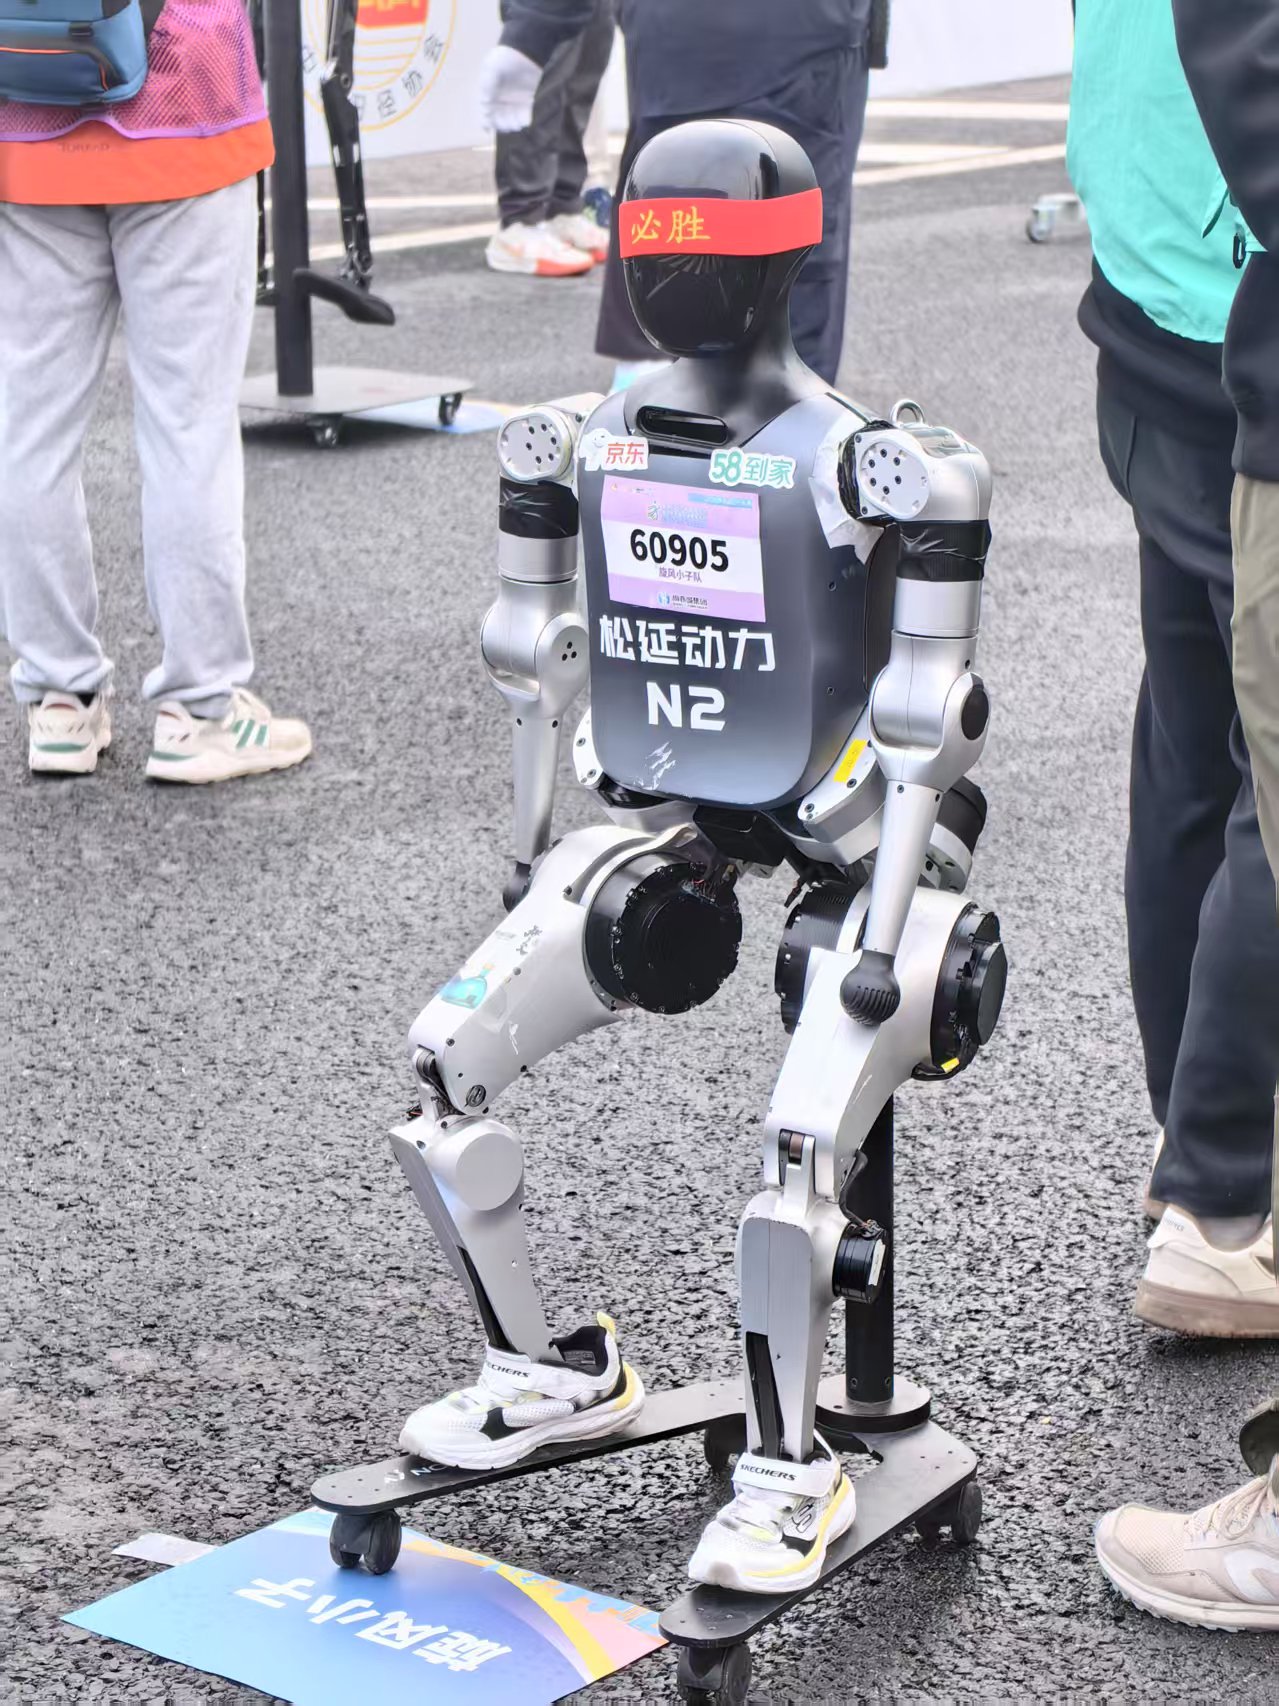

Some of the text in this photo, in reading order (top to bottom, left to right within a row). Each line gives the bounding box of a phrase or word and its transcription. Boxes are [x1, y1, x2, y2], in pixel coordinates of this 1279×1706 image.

[631, 206, 711, 244] 必胜
[606, 442, 645, 465] 京东
[711, 450, 794, 486] 58到家
[630, 528, 729, 572] 60905
[658, 566, 703, 584] 旋风小子队
[599, 614, 776, 671] 松延动力
[646, 681, 726, 732] N2
[740, 1463, 797, 1481] SKECHERS
[234, 1578, 513, 1672] 旋风小子
